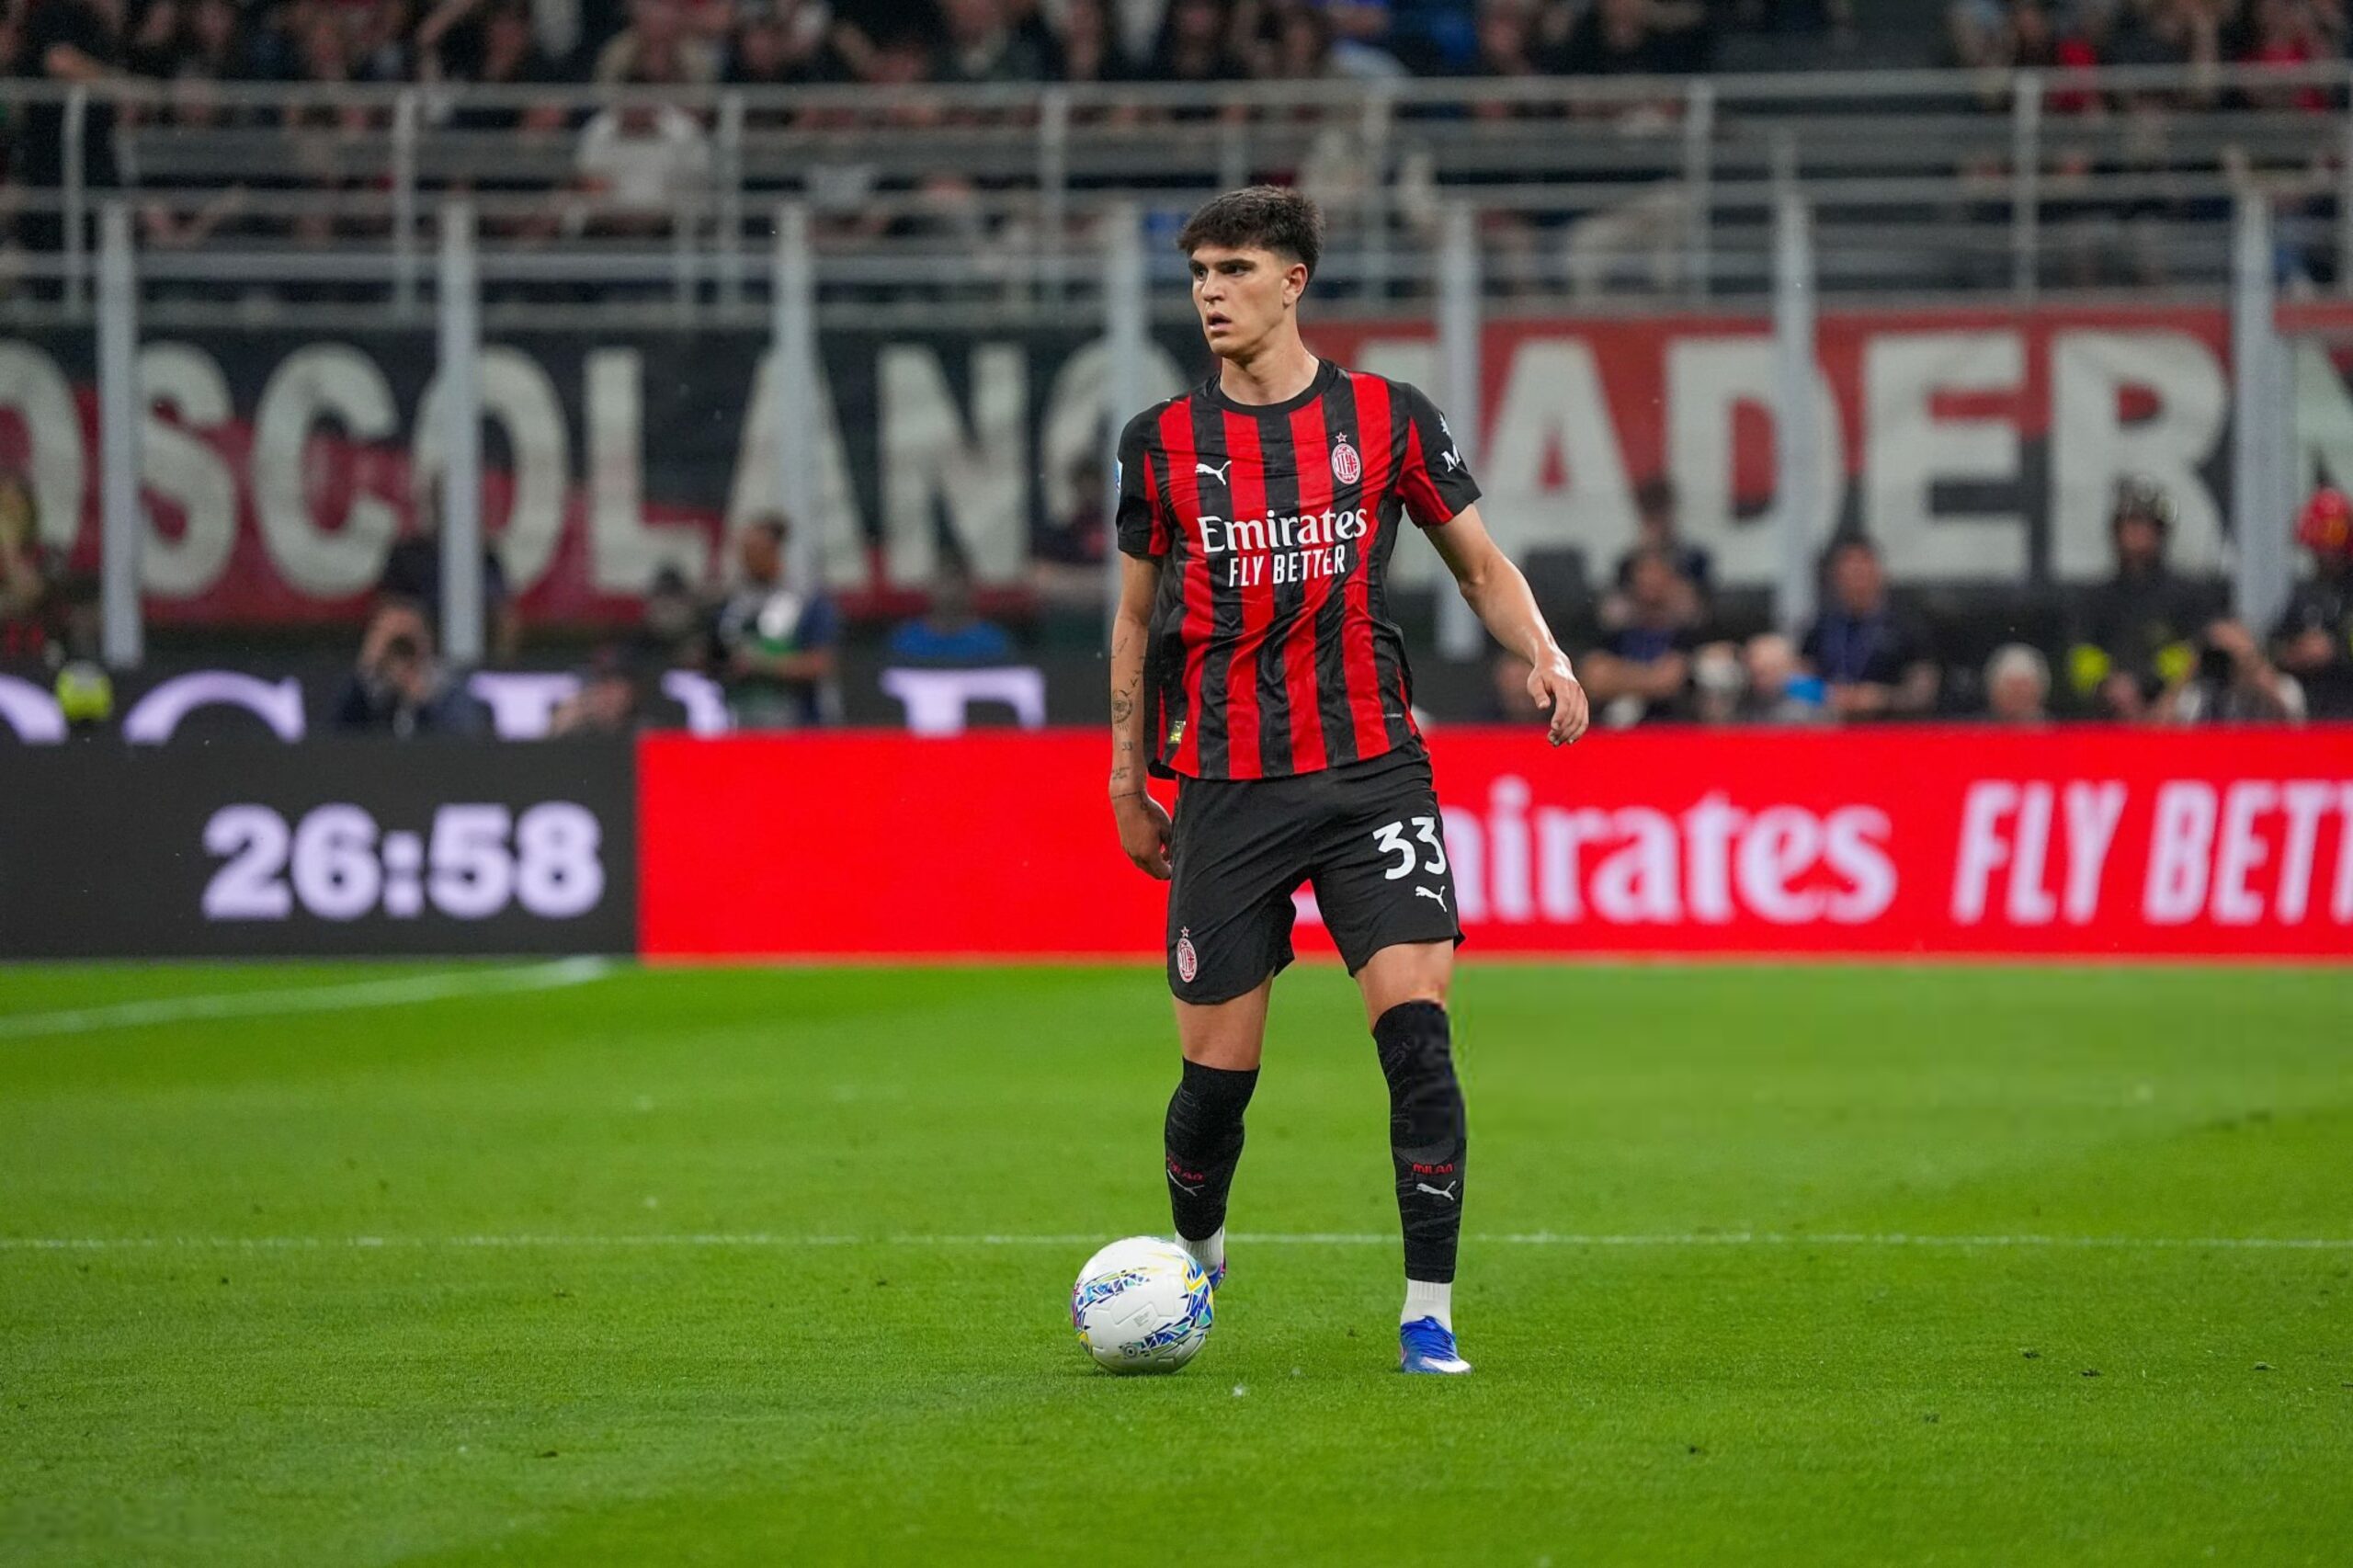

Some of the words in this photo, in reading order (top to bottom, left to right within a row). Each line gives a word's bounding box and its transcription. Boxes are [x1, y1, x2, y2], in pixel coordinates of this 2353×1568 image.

[1197, 507, 1368, 553] Emirates
[1228, 554, 1265, 587] FLY
[1272, 544, 1346, 585] BETTER
[200, 801, 606, 920] 26:58
[1371, 816, 1448, 881] 33
[1949, 779, 2128, 926] FLY
